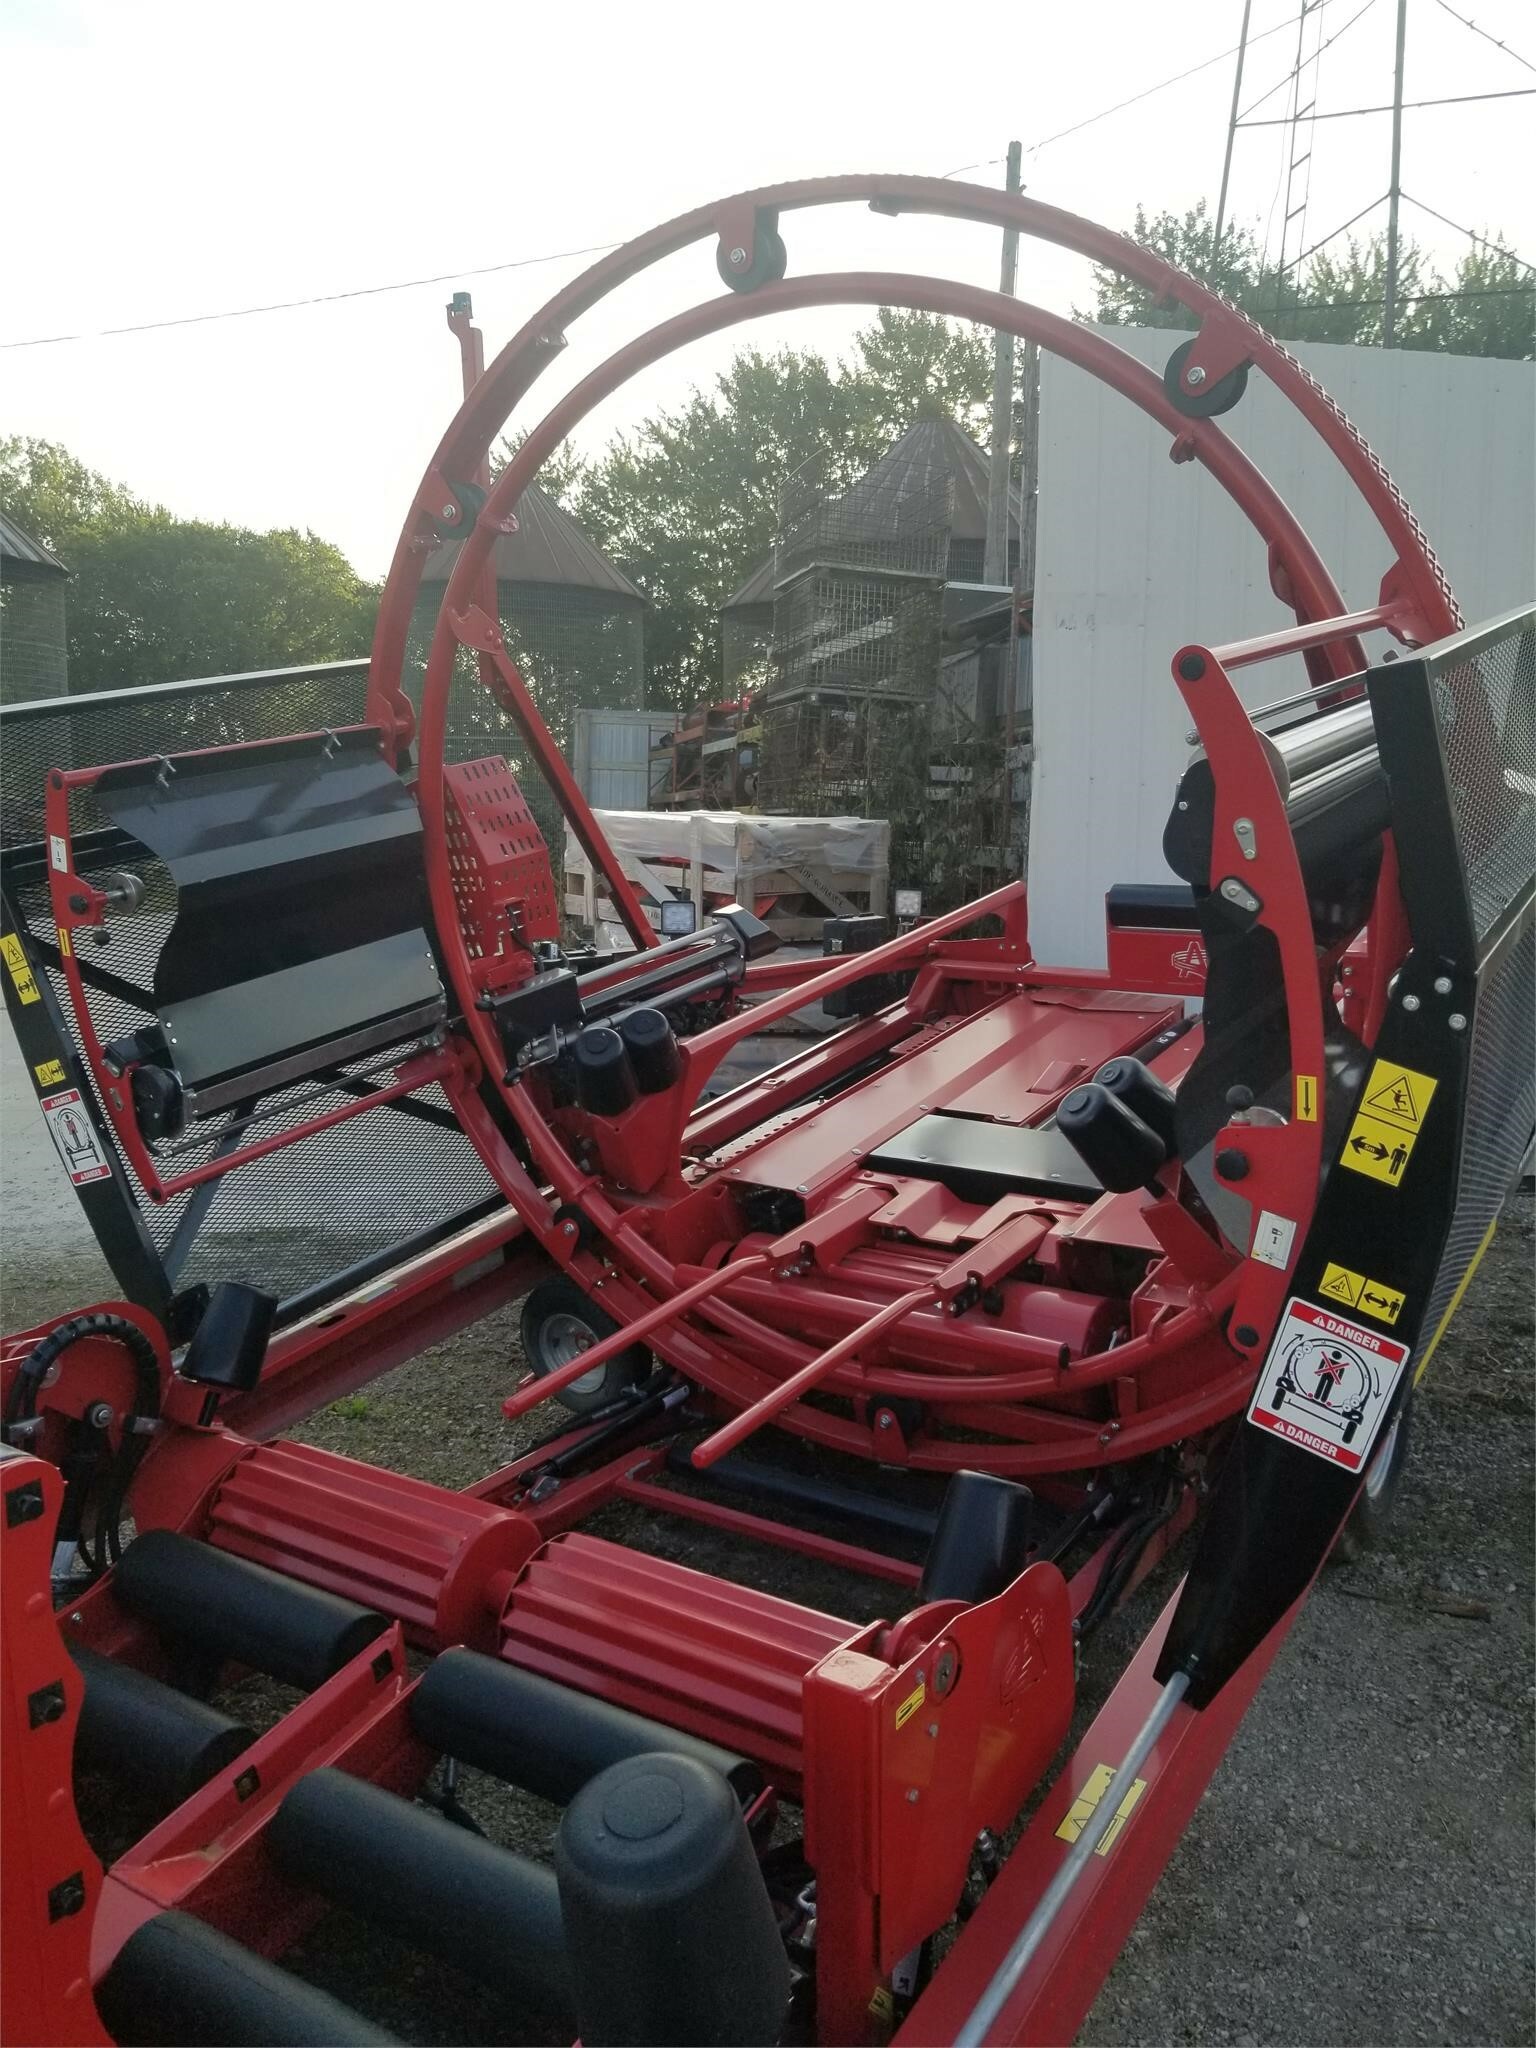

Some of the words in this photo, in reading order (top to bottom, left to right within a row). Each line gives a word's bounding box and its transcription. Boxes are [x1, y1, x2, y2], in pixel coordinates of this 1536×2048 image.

[1364, 1144, 1376, 1153] 5m
[1326, 1317, 1381, 1352] DANGER
[1286, 1423, 1338, 1458] DANGER
